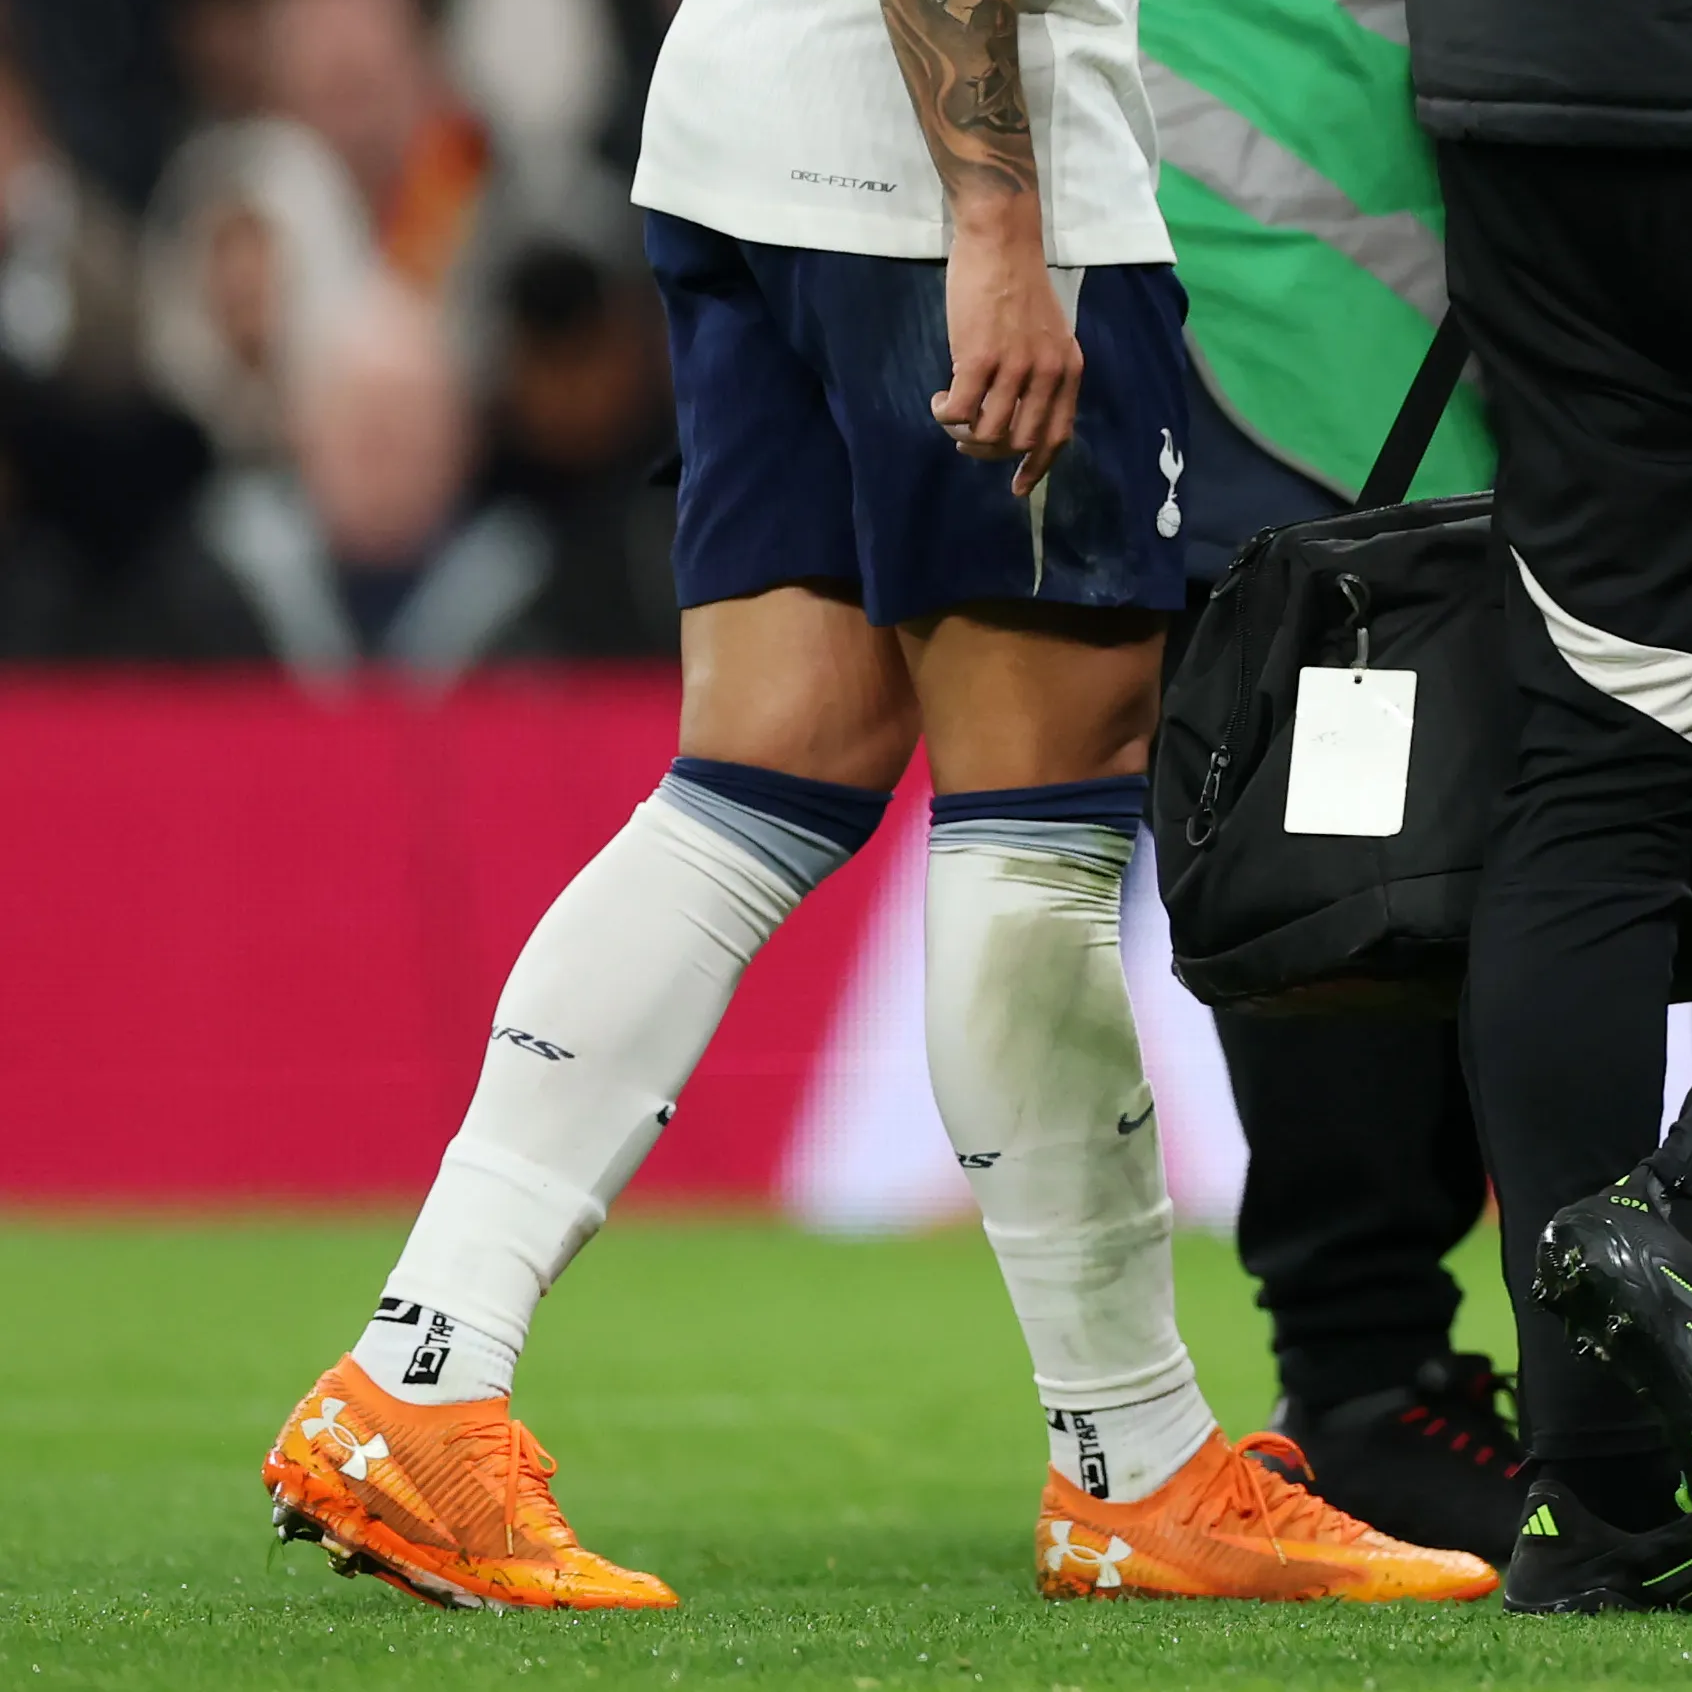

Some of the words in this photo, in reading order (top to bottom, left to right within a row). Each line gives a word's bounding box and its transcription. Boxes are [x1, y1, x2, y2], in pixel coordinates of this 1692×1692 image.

[1610, 1195, 1649, 1213] COPA
[424, 1311, 455, 1344] TAP
[1072, 1411, 1099, 1453] TAP
